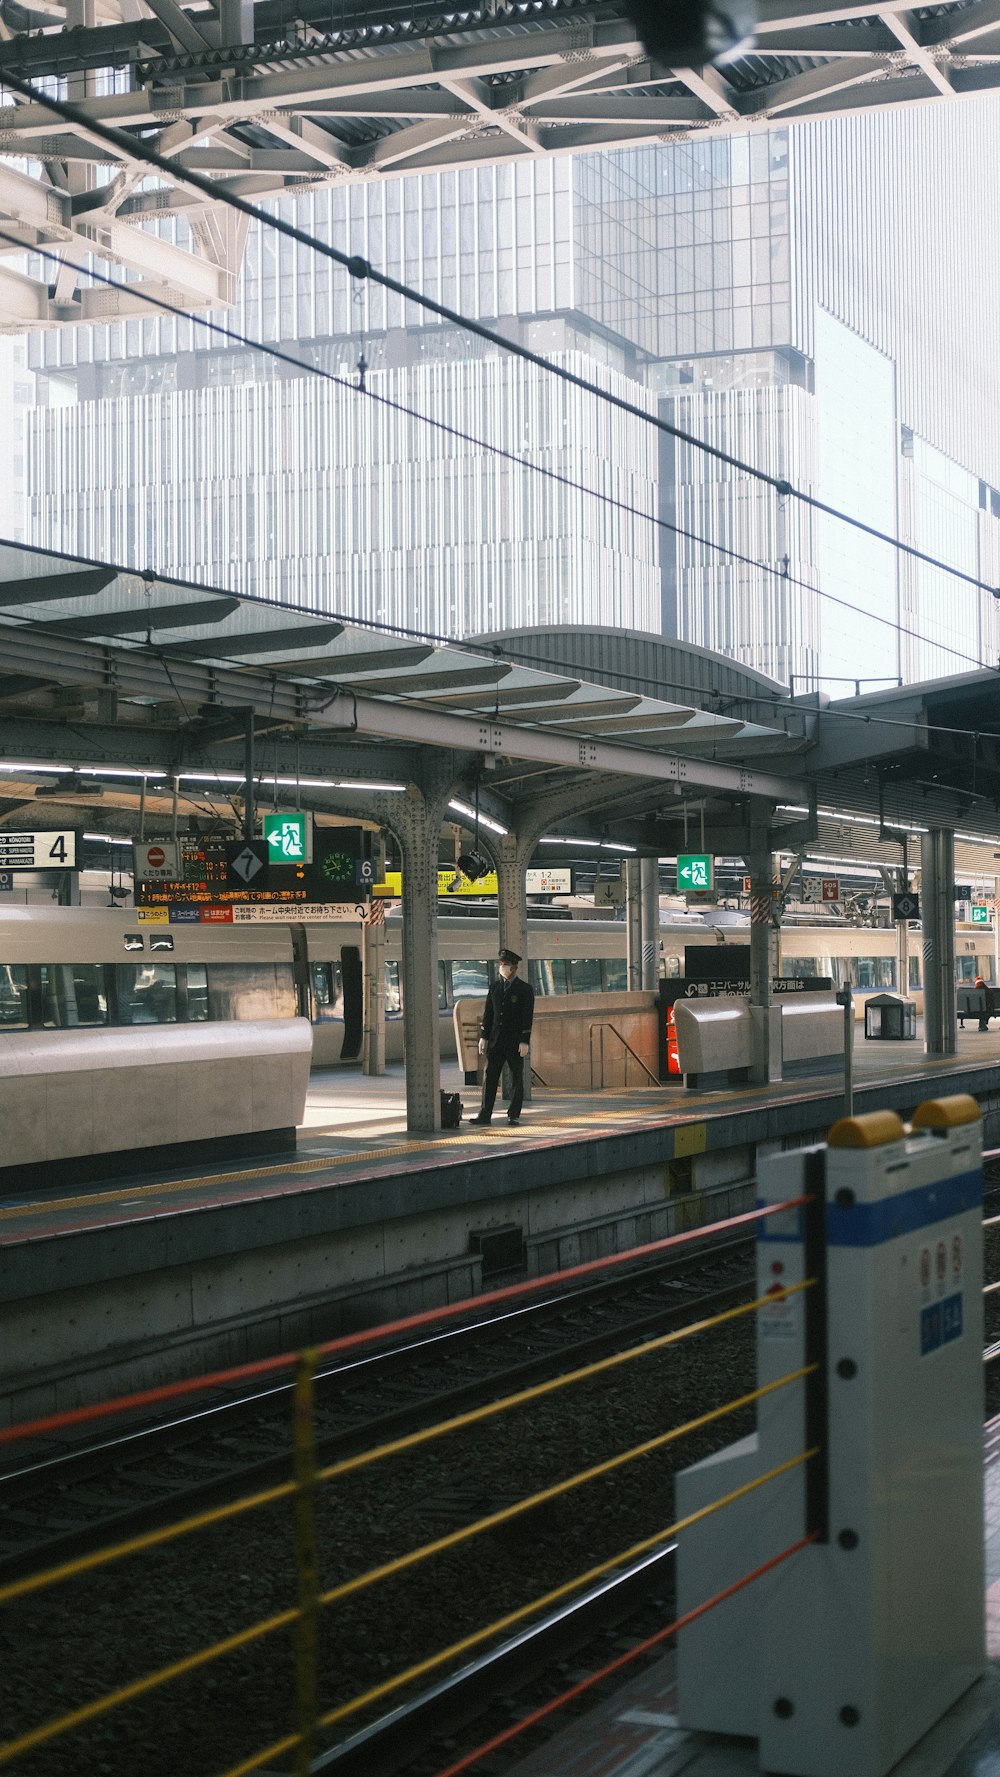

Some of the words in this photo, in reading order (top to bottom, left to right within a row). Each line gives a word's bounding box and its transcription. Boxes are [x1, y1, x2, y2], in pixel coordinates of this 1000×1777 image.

[49, 836, 67, 863] 4
[241, 854, 254, 879] 7
[361, 861, 372, 877] 6
[961, 886, 968, 896] 5
[259, 905, 352, 915] ホーム中央付近でお待ち下さい。
[902, 901, 909, 911] 8
[710, 981, 752, 990] ユニバーサル
